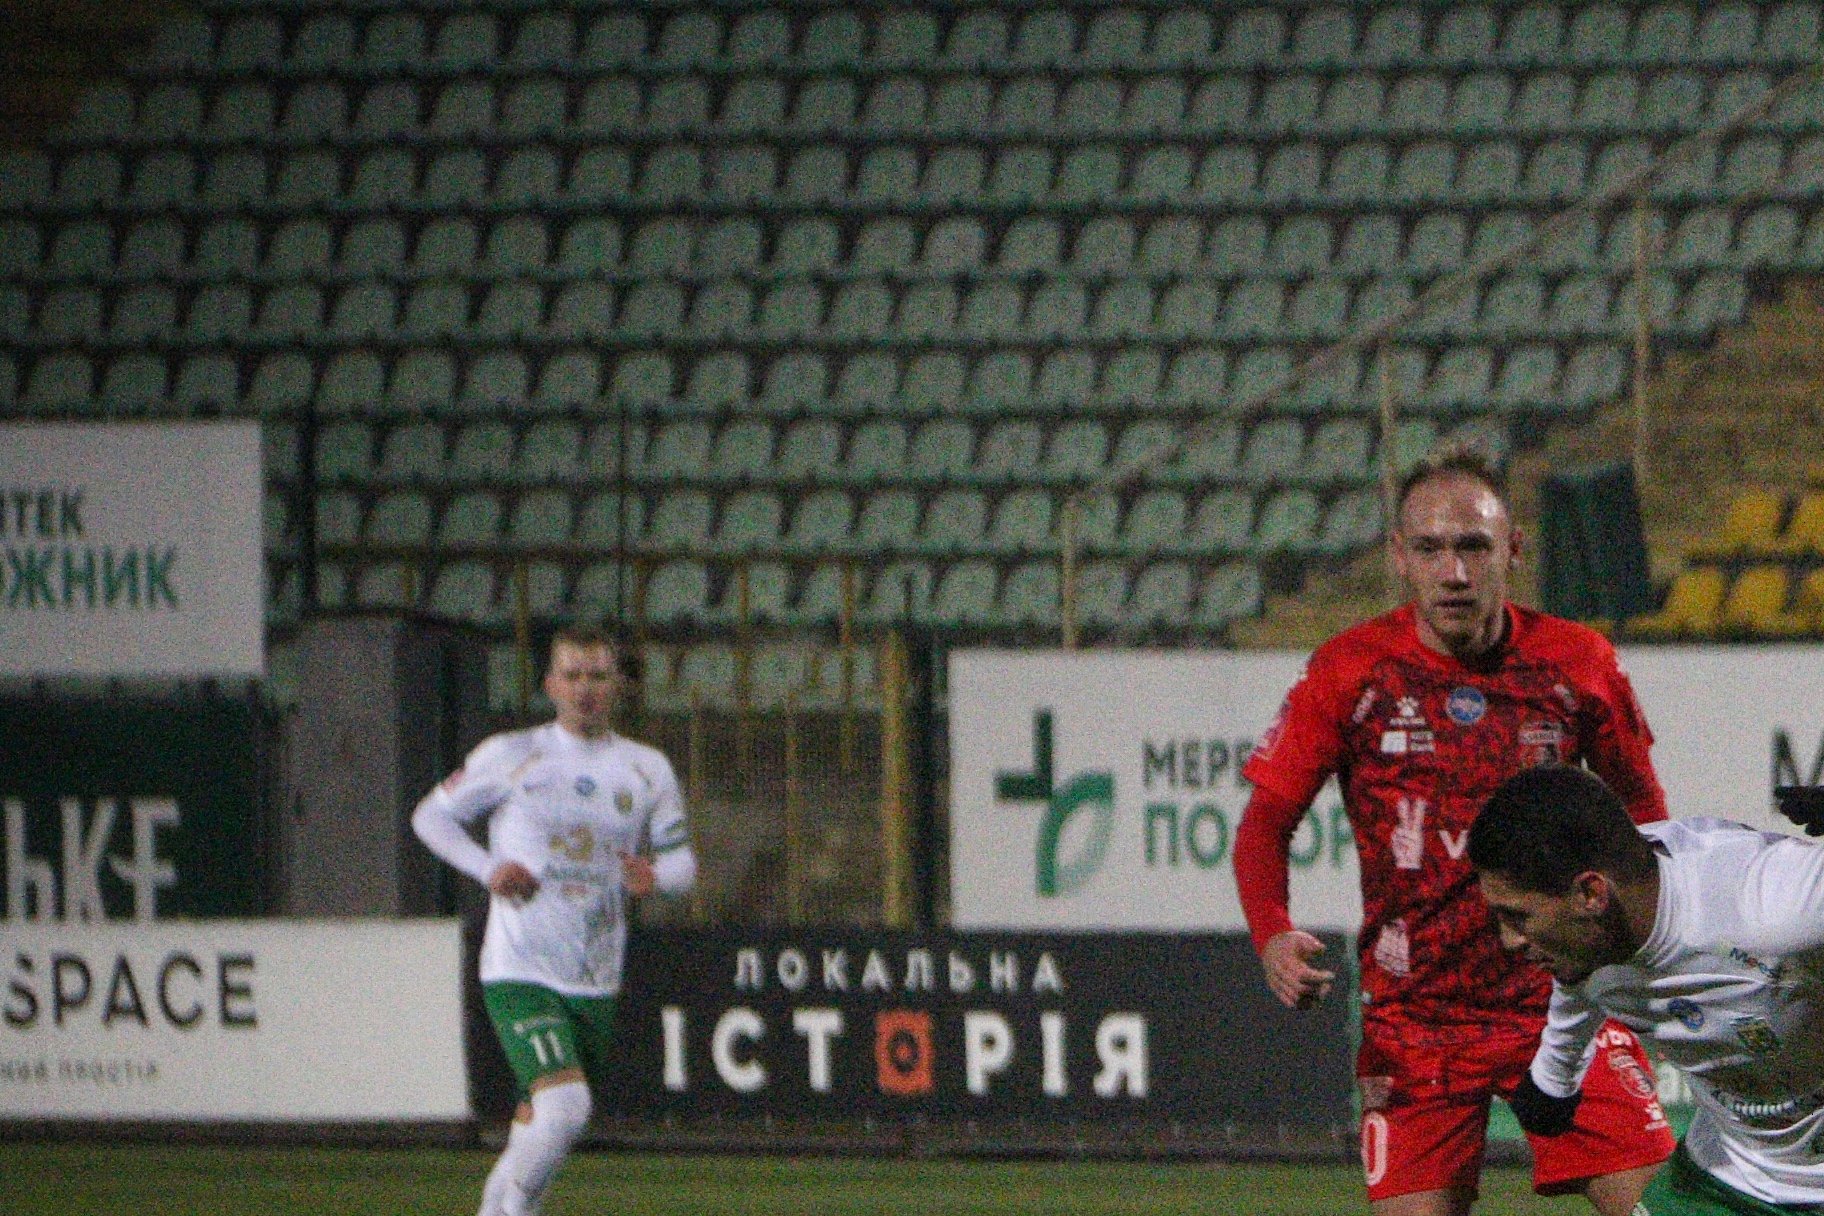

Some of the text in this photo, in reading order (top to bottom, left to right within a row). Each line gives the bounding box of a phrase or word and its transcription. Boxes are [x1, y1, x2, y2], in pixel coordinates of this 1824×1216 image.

[0, 488, 84, 537] ТЕК
[0, 546, 178, 608] ЖНИК
[3, 950, 257, 1028] SPACE
[735, 948, 1065, 993] ЛОКАЛЬНА
[660, 1007, 1151, 1100] ІСТОРІЯ
